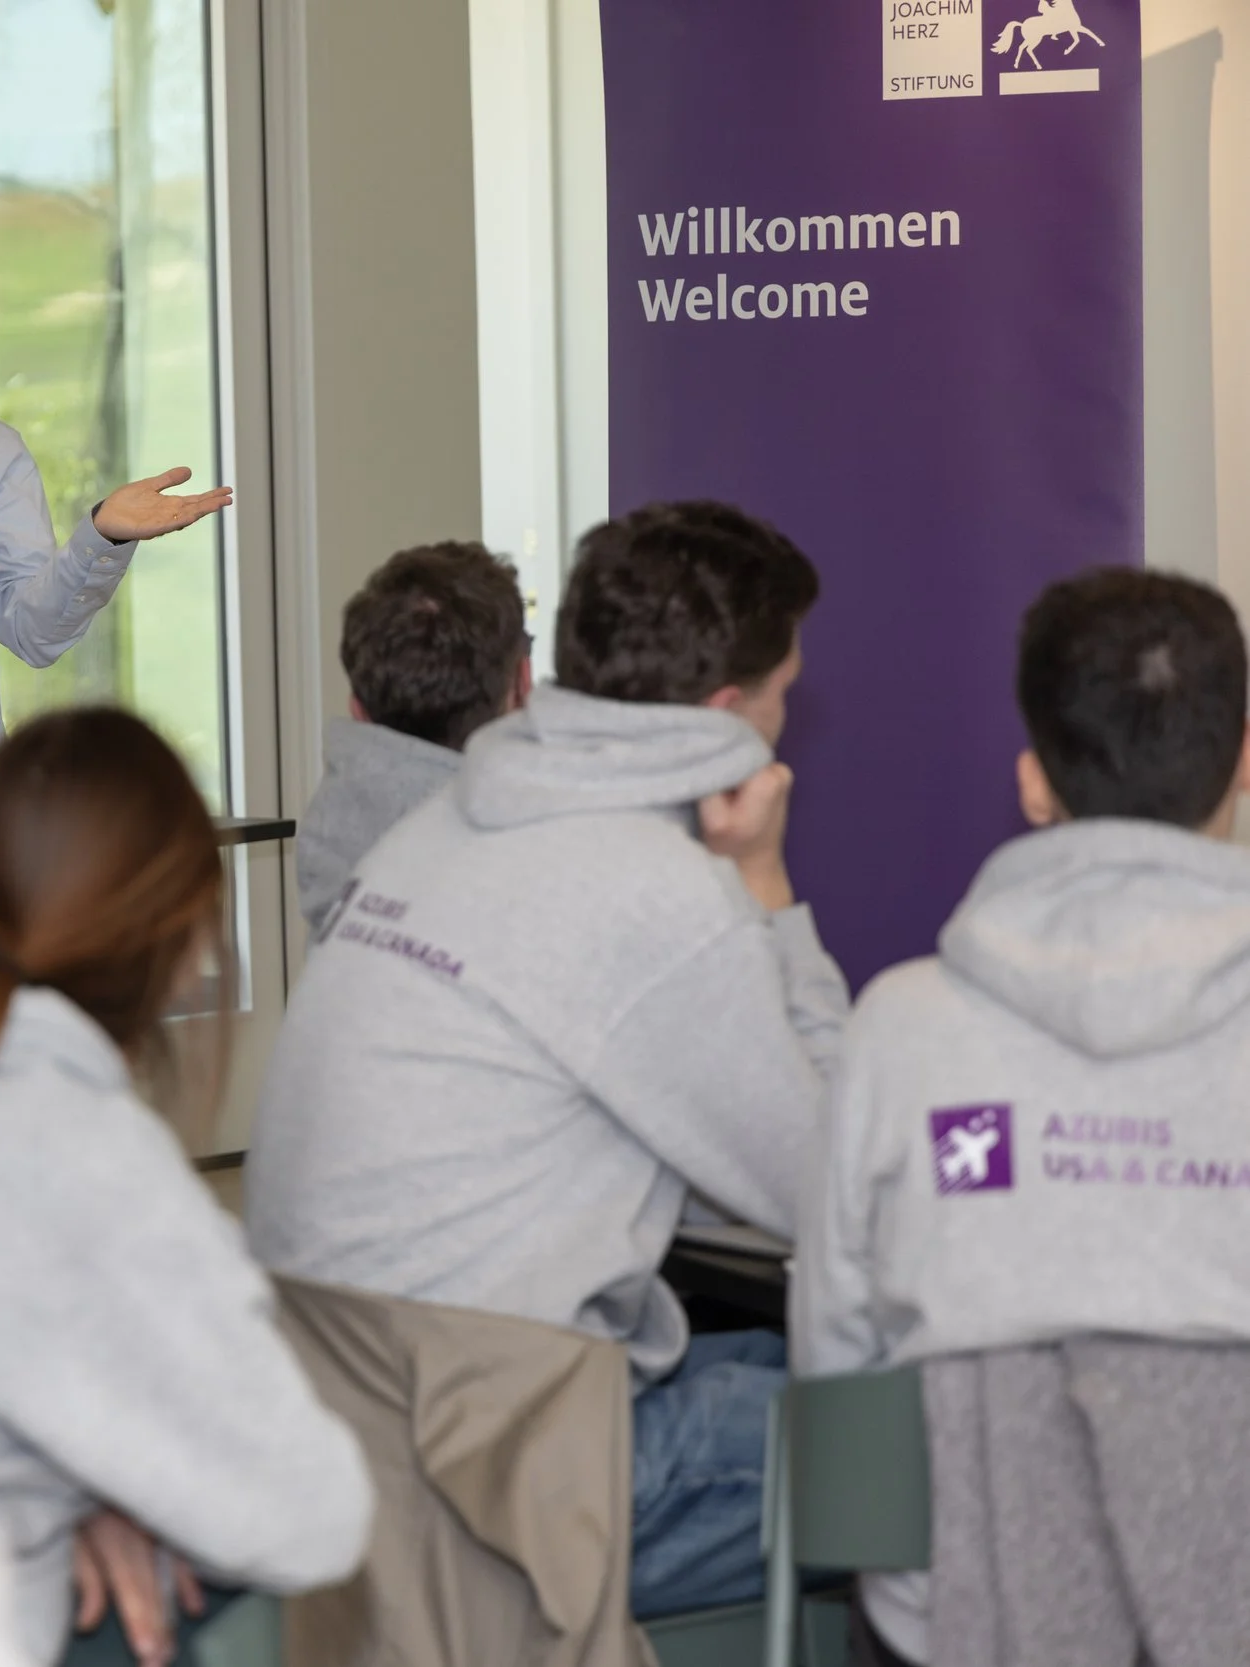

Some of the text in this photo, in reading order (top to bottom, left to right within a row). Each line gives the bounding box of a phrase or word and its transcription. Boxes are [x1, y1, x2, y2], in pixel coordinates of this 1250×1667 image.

[890, 0, 973, 21] JOACHIM
[892, 23, 939, 40] HERZ
[890, 74, 974, 92] STIFTUNG
[638, 206, 961, 256] Willkommen
[638, 273, 869, 322] Welcome
[1042, 1113, 1171, 1148] AZUBIS
[1042, 1152, 1113, 1183] USA
